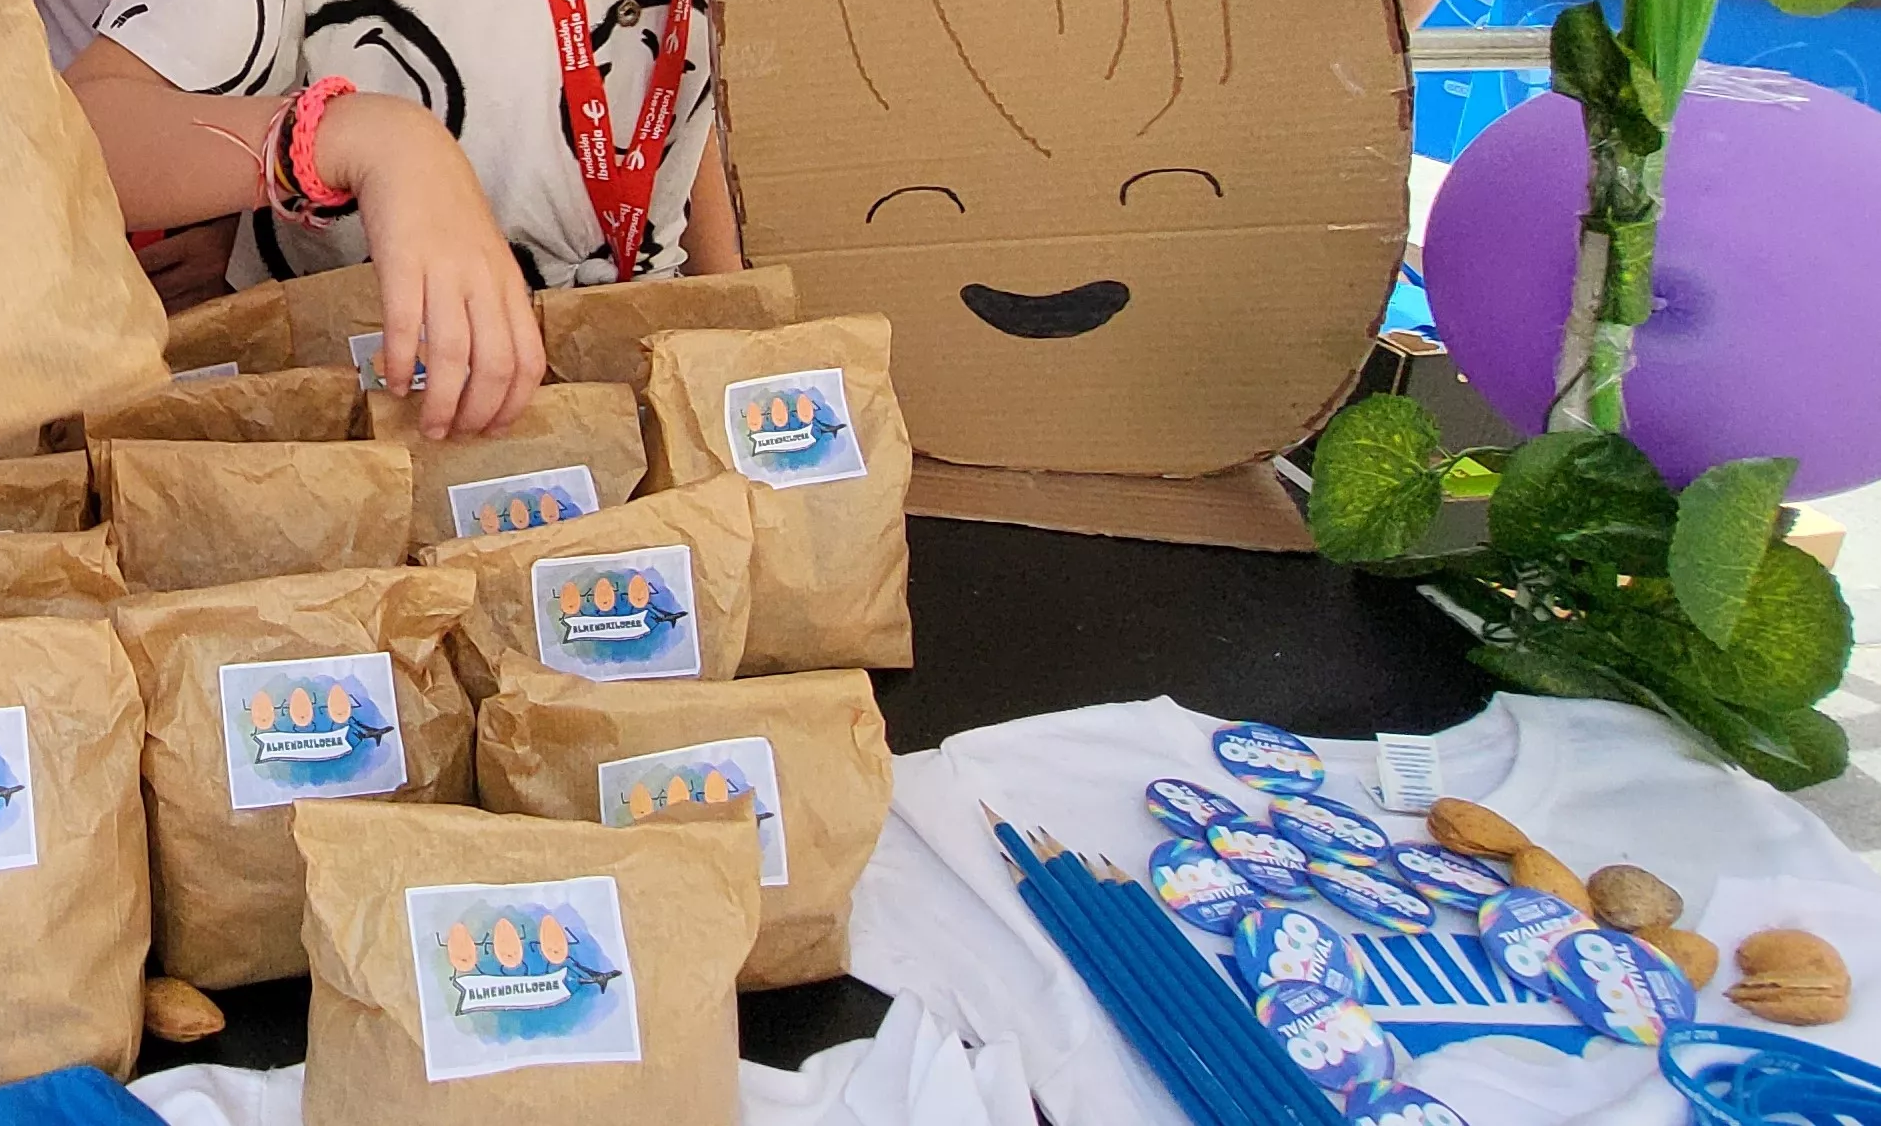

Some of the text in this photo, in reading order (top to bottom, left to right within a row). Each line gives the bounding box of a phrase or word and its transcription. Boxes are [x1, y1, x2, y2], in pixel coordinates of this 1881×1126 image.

[557, 18, 577, 71] Fundación
[651, 89, 674, 140] Fundación
[578, 132, 595, 180] Fundación
[266, 736, 344, 753] ALMENDRILOCAS
[1215, 825, 1307, 864] LOCO
[468, 979, 561, 1002] ALMENDRILOCAS
